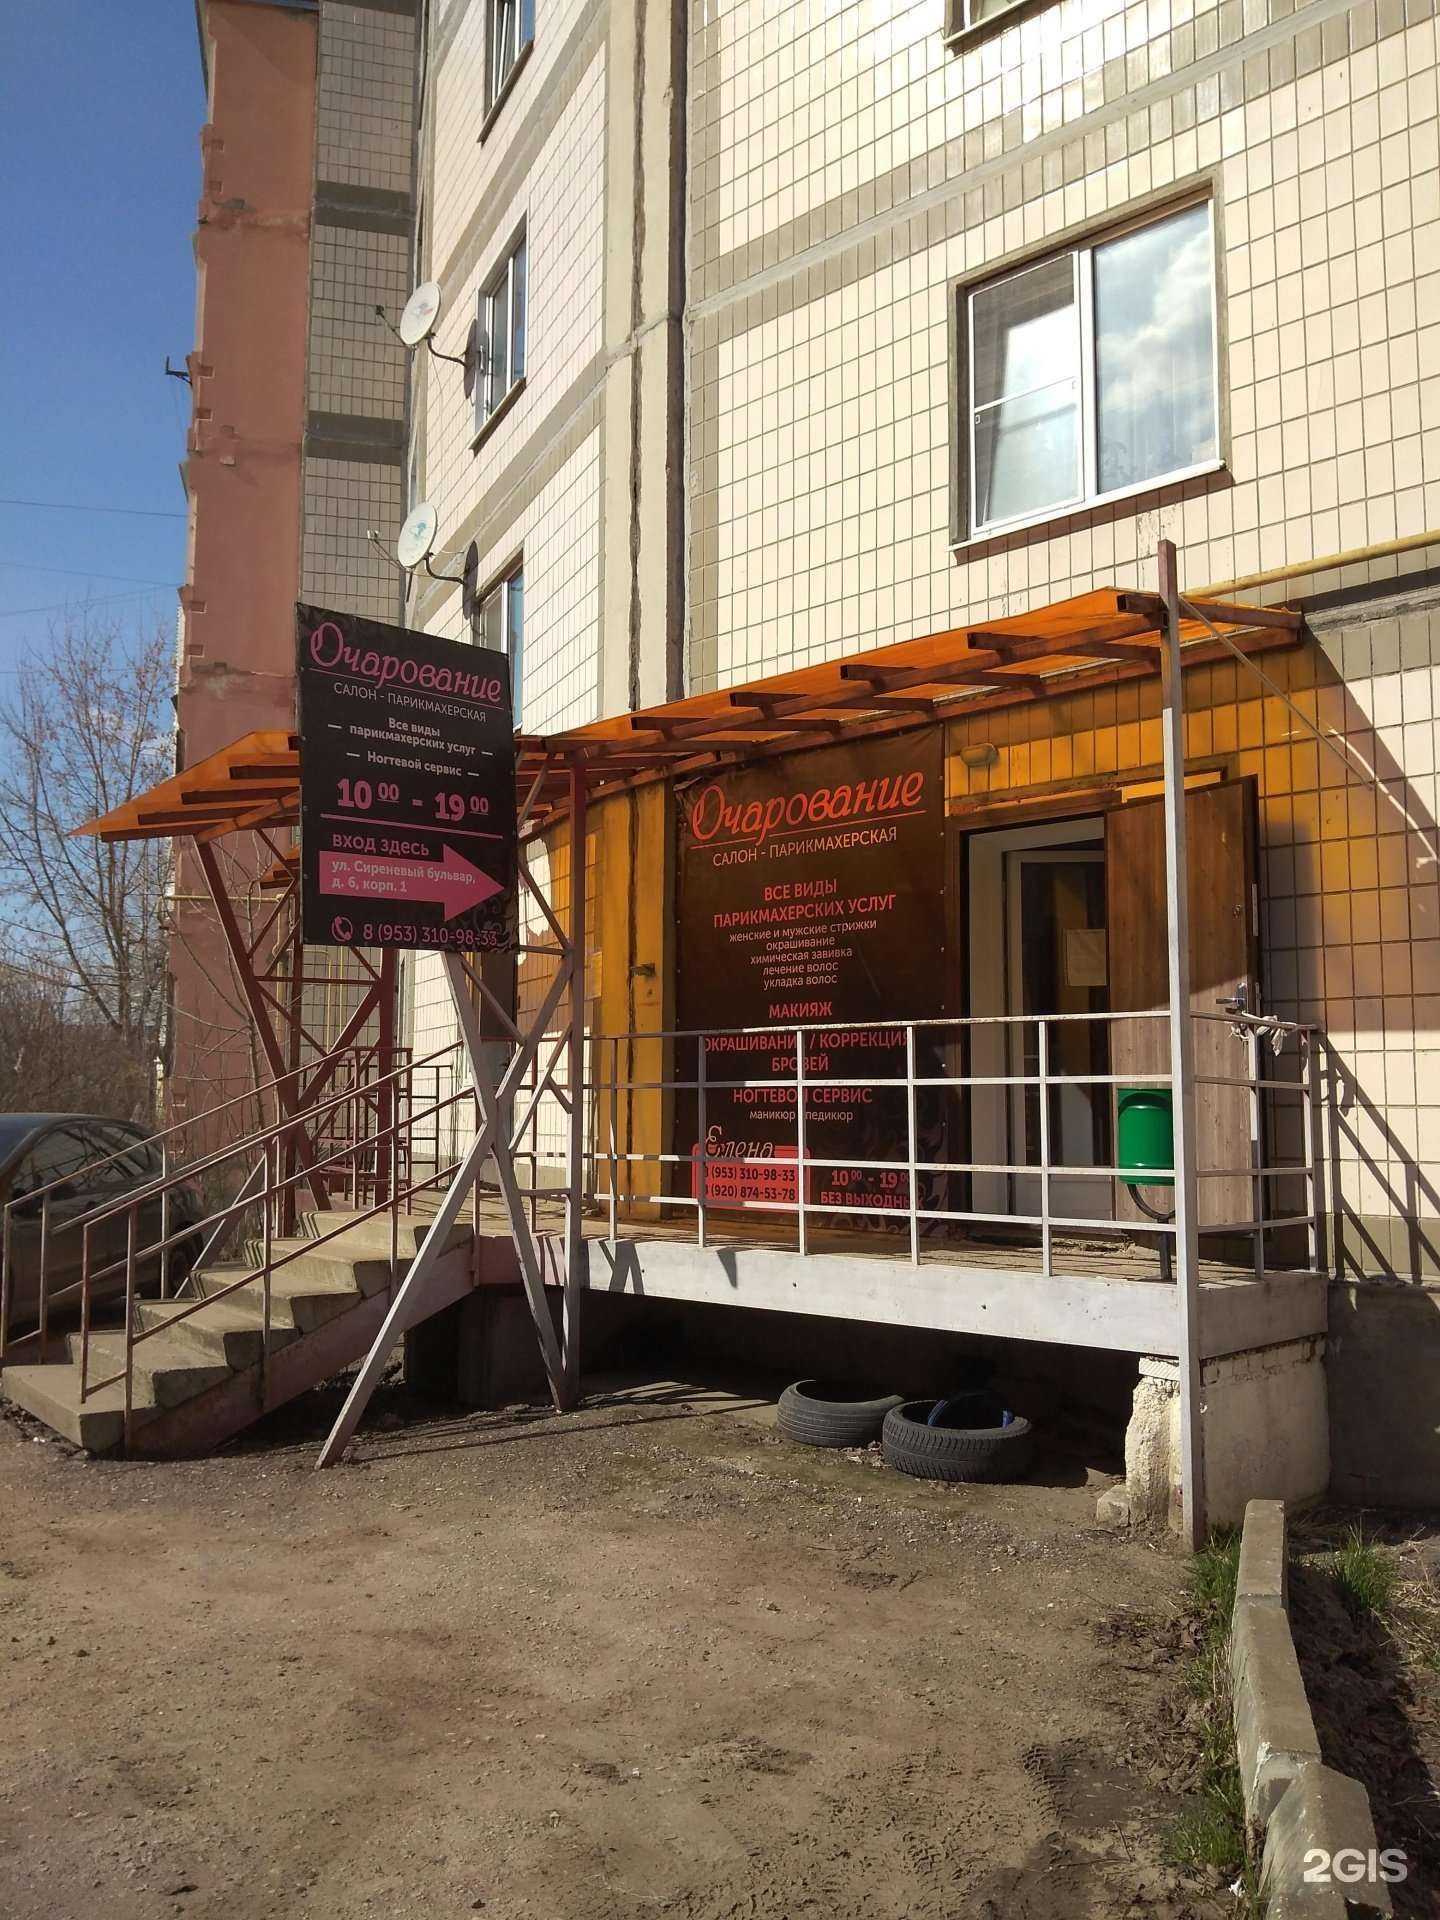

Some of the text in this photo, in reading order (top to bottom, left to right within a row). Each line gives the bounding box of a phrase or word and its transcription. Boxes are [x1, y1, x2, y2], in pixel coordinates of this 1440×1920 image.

[310, 621, 501, 702] Очарование
[333, 682, 377, 701] САЛОН
[387, 693, 487, 722] ПАРИКМАХЕРСКАЯ
[388, 717, 440, 737] Все виды
[350, 724, 476, 757] парикмахерских услуг
[367, 750, 462, 776] Ногтевой сервис
[336, 778, 372, 810] 10
[434, 792, 465, 822] 19
[691, 771, 925, 846] Очарование
[332, 834, 376, 853] ВХОД
[713, 848, 757, 867] САЛОН
[769, 826, 897, 859] ПАРИКМАХЕРСКАЯ
[331, 861, 351, 873] ул.
[354, 860, 424, 878] Сиреневый
[331, 876, 408, 893] д. 6, корп. 1
[764, 879, 837, 901] ВСЕ ВИДЫ
[713, 894, 896, 929] ПАРИКМАХЕРСКИХ УСЛУГ
[363, 923, 498, 946] 8 (953) 310-98-33
[729, 919, 877, 943] женские и мужские стрижки
[766, 936, 835, 952] окрашивание
[750, 947, 852, 965] химическая завивка
[763, 961, 839, 976] лечение волос
[763, 973, 838, 990] укладка волос
[769, 1001, 832, 1019] МАКИЯЖ
[812, 1088, 873, 1104] СЕРВИС
[750, 1110, 853, 1123] маникюр педикюр
[705, 1125, 773, 1158] Елена
[711, 1166, 737, 1178] (953)
[740, 1168, 795, 1182] 310-98-33
[831, 1169, 849, 1186] 10
[880, 1172, 898, 1188] 19
[711, 1184, 738, 1197] (920)
[740, 1187, 795, 1200] 874-53-78
[820, 1191, 842, 1205] БЕЗ
